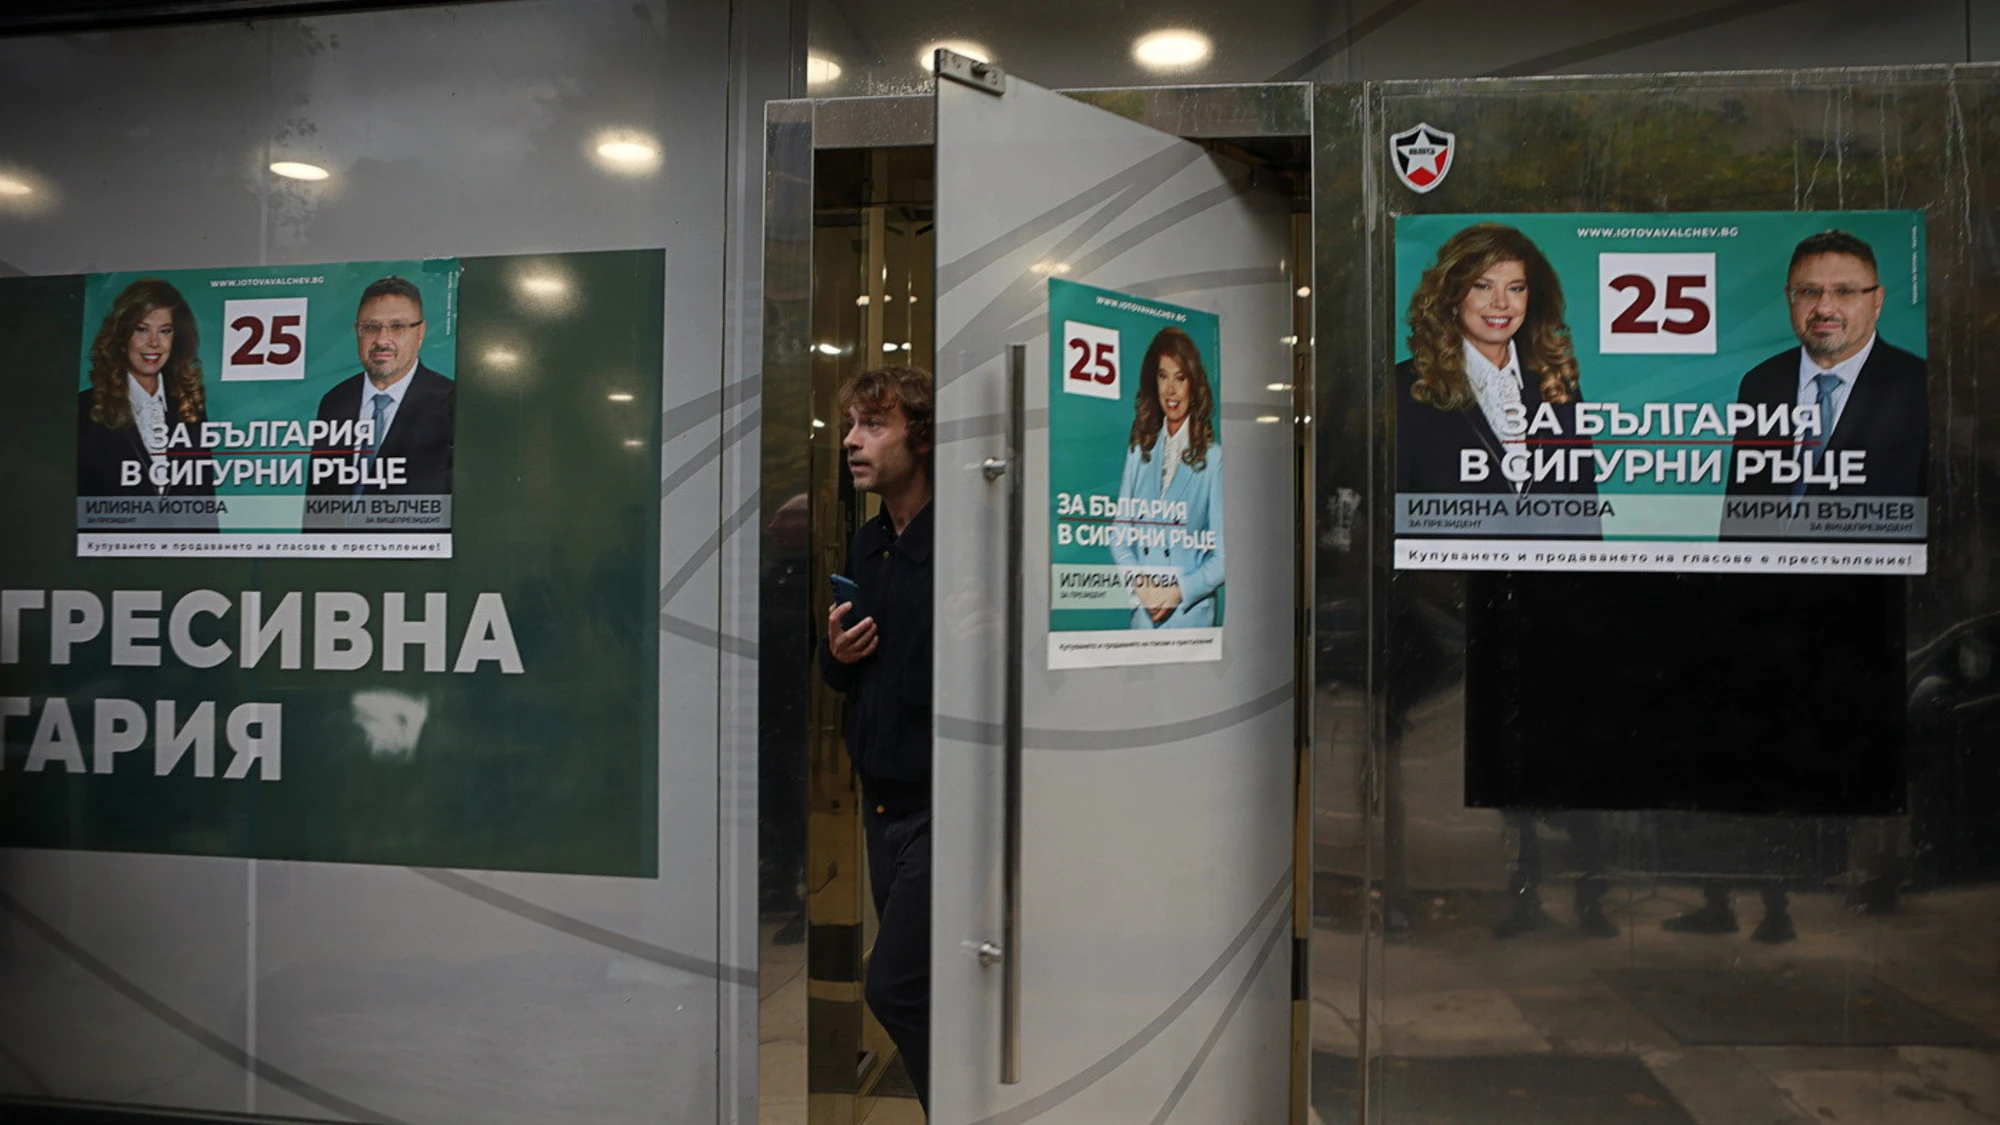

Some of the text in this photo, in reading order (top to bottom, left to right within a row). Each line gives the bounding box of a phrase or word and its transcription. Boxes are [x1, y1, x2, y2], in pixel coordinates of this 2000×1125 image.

[1577, 227, 1739, 238] WWW.IOTOVAVALCHEV.BG
[210, 276, 324, 287] WWW.IOTOVAVALCHEV.BG
[1608, 274, 1710, 335] 25
[230, 315, 302, 365] 25
[1069, 338, 1116, 385] 25
[1503, 403, 1822, 436] ЗА БЪЛГАРИЯ
[150, 419, 375, 448] ЗА БЪЛГАРИЯ
[120, 457, 407, 489] В СИГУРНИ РЪЦЕ
[1460, 449, 1867, 490] В СИГУРНИ РЪЦЕ
[86, 497, 228, 514] ИЛИЯНА ЙОТОВА
[307, 500, 441, 514] КИРИЛ ВЪЛЧЕВ
[1057, 493, 1187, 520] ЗА БЪЛГАРИЯ
[1408, 496, 1615, 517] ИЛИЯНА ЙОТОВА
[1727, 501, 1914, 520] КИРИЛ ВЪЛЧЕВ
[1409, 519, 1482, 529] ЗА ПРЕЗИДЕНТ
[87, 542, 155, 551] Купуването
[173, 542, 252, 551] продаването
[276, 543, 325, 551] гласове
[343, 543, 441, 552] престъпление!
[1057, 524, 1217, 552] В СИГУРНИ РЪЦЕ
[1409, 550, 1510, 562] Купуването
[1518, 553, 1526, 561] и
[1535, 553, 1647, 564] продаването
[1655, 554, 1675, 562] на
[1682, 554, 1752, 563] гласове
[1778, 554, 1912, 566] престъпление!
[1060, 570, 1179, 588] ИЛИЯНА ЙОТОВА
[1, 590, 524, 674] ГРЕСИВНА
